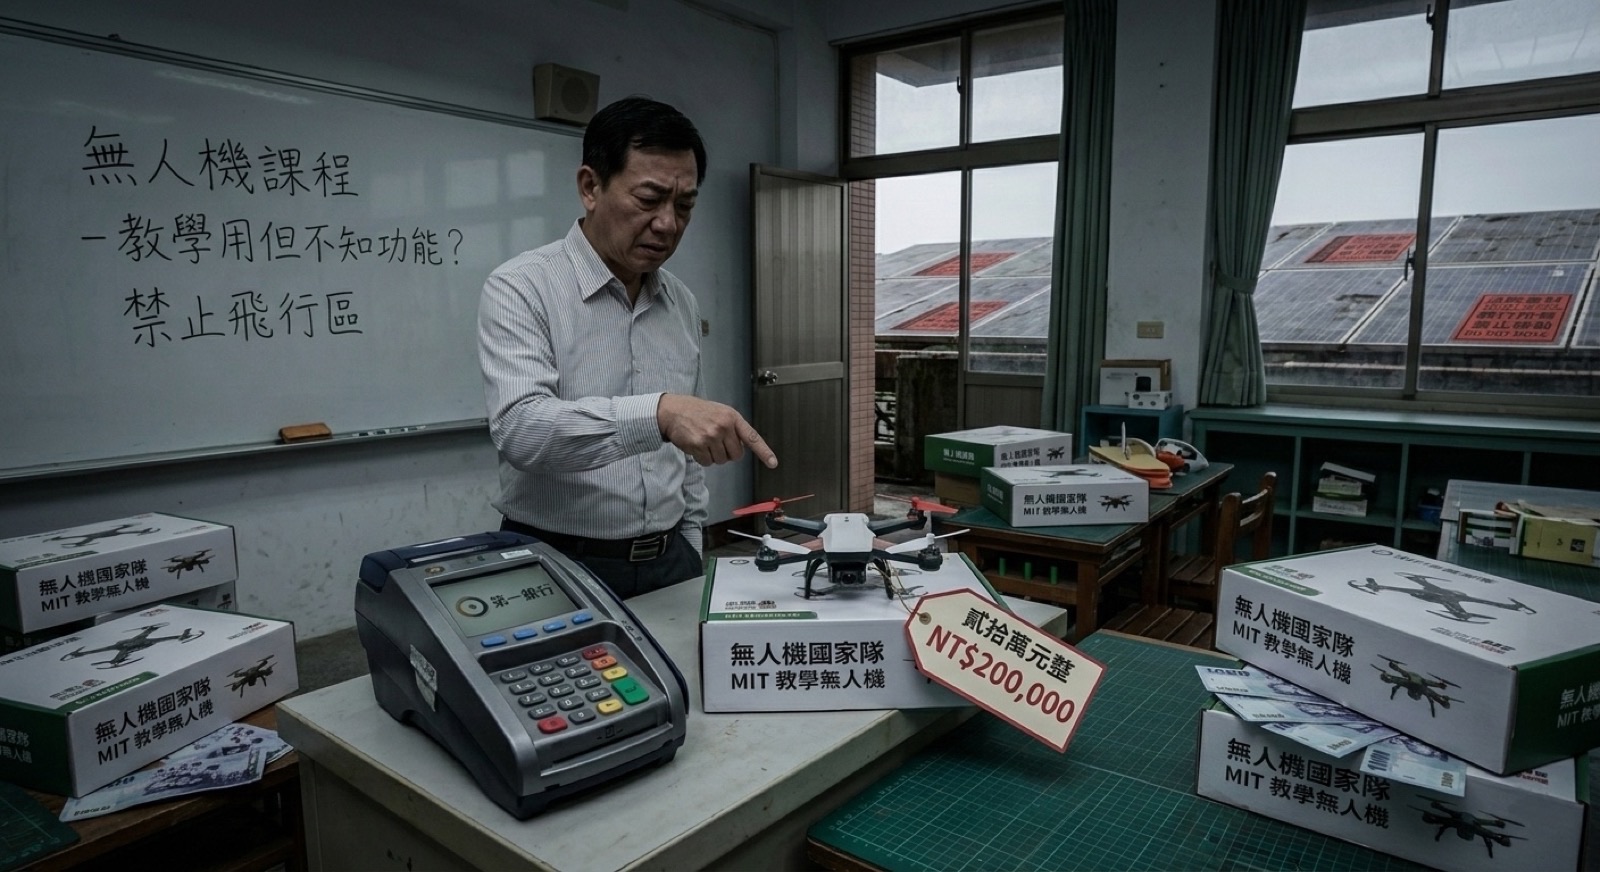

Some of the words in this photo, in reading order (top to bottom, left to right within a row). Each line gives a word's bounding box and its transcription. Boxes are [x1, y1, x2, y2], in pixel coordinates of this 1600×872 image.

[82, 125, 359, 198] 無人機課程
[123, 287, 363, 347] 禁止飛行區
[41, 595, 70, 612] MIT
[1235, 594, 1355, 658] 無人機國家隊
[730, 640, 885, 666] 無人機國家隊
[926, 625, 1075, 723] NT$200,000
[961, 607, 1076, 684] 貳拾萬元整
[1232, 620, 1261, 644] MIT
[1264, 632, 1351, 685] 教學無人機
[94, 676, 212, 745] 無人機國家隊
[731, 673, 770, 690] MIT
[775, 668, 886, 691] 教學無人機
[97, 738, 131, 766] MIT
[1227, 738, 1391, 801] 無人機國家隊
[1225, 765, 1265, 790] MIT
[1269, 776, 1390, 829] 教學無人機
